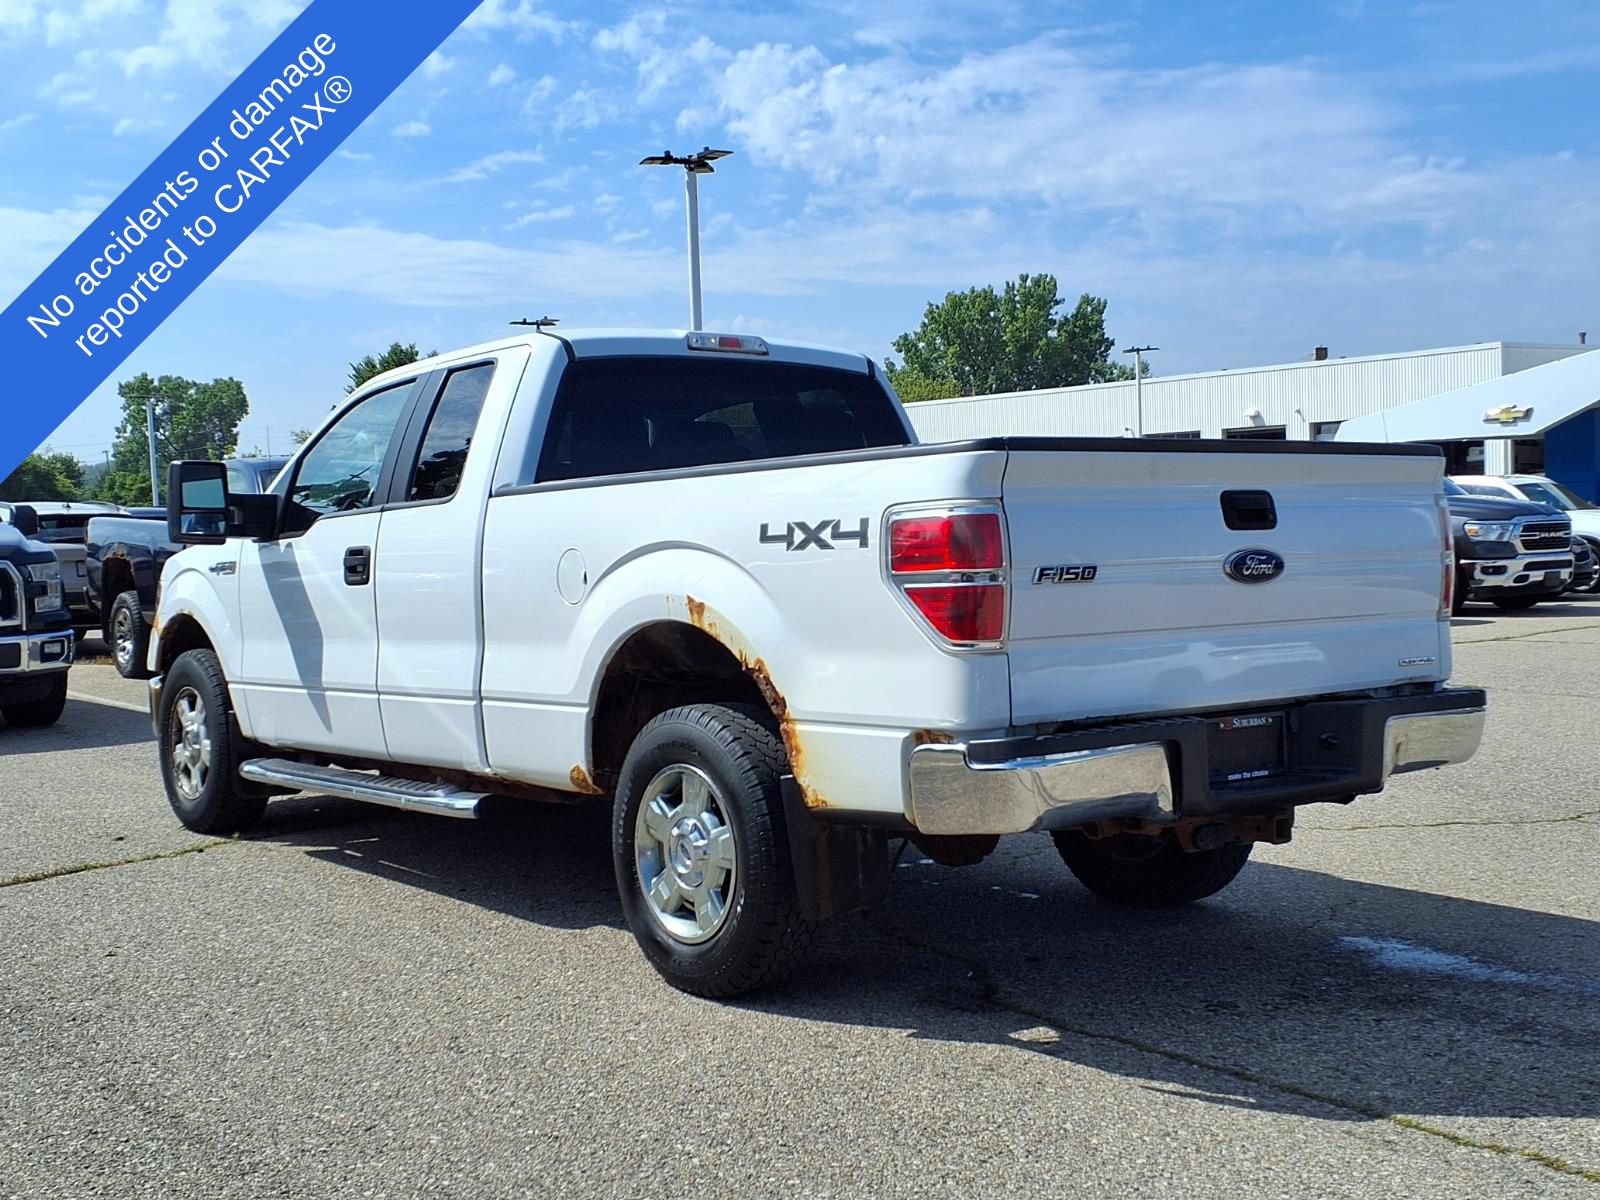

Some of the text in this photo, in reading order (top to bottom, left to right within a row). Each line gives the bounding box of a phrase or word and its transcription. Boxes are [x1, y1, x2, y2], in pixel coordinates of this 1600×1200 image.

[759, 517, 870, 552] 4X4
[1242, 554, 1276, 576] Ford
[1242, 771, 1251, 779] the
